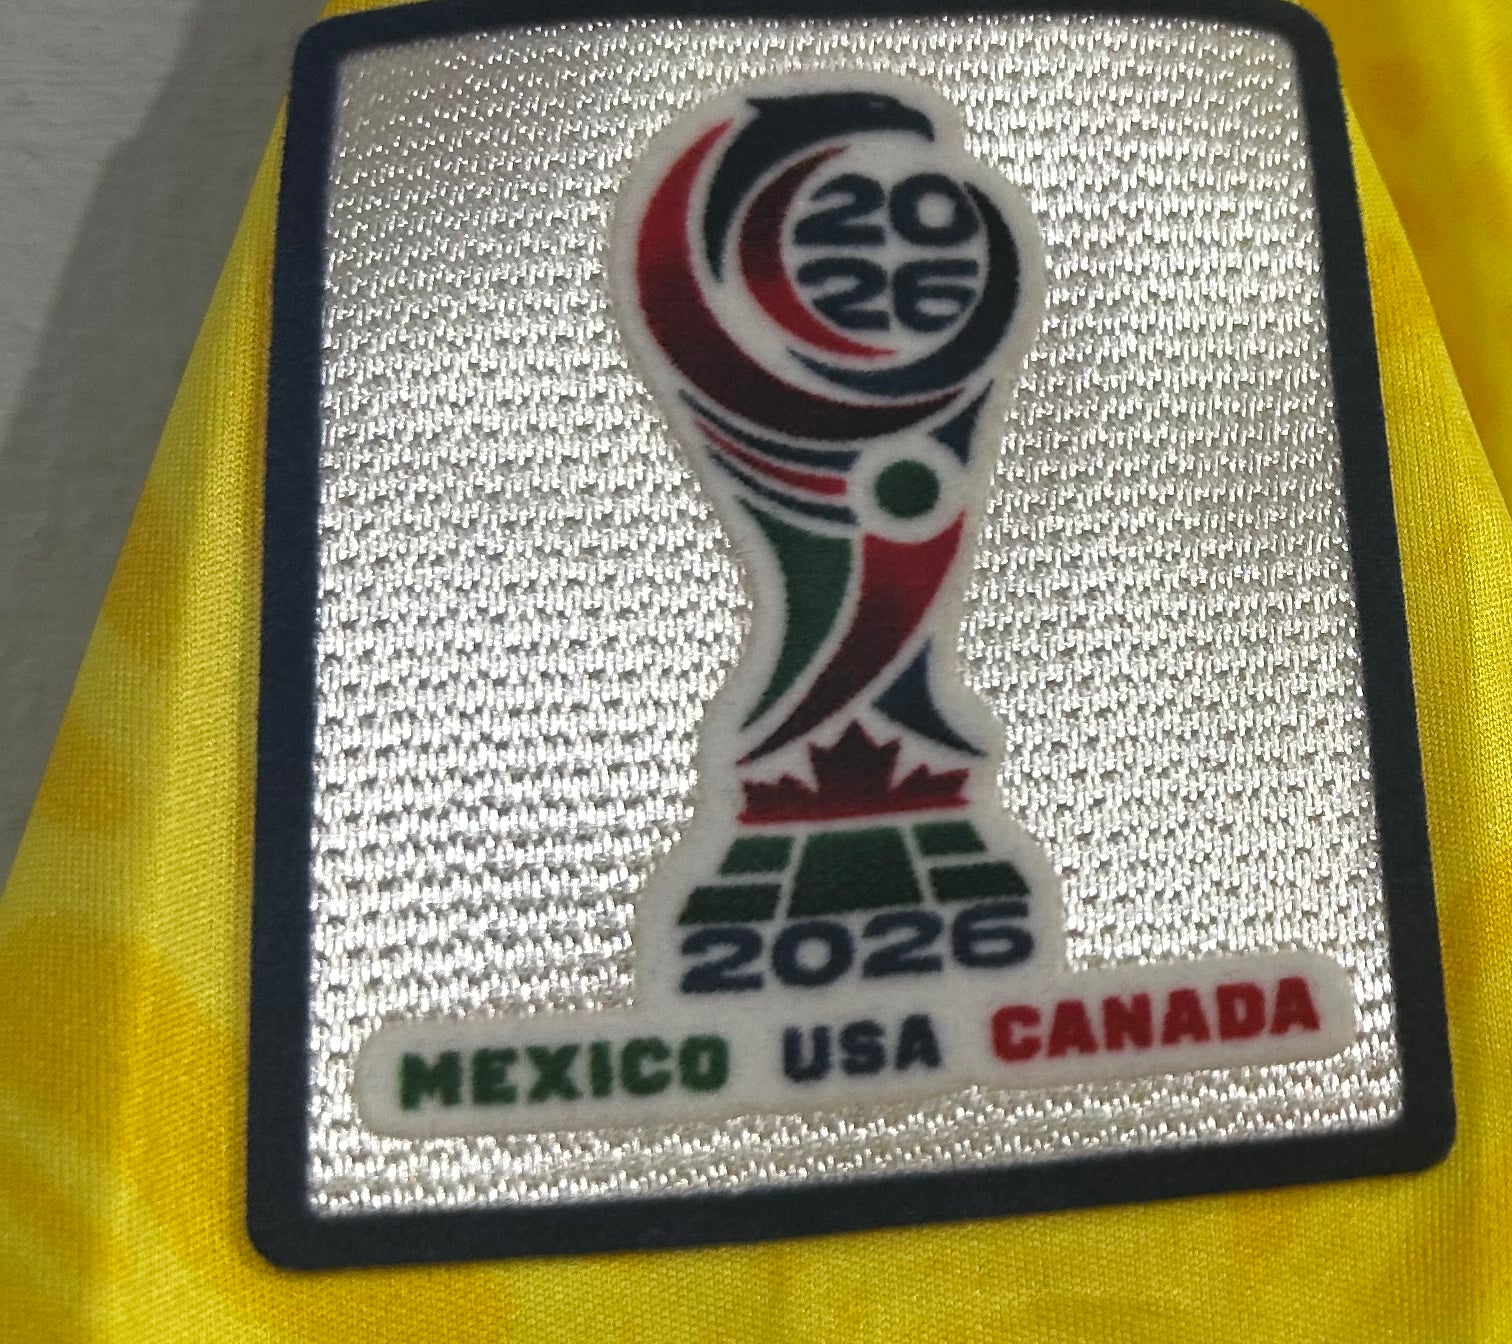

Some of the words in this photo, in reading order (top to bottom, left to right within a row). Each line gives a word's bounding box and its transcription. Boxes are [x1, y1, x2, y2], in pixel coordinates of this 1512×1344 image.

[794, 173, 979, 246] 20
[796, 257, 978, 333] 26
[678, 909, 1036, 993] 2026
[399, 1034, 731, 1110] MEXICO
[780, 1014, 942, 1084] USA
[990, 976, 1322, 1062] CANADA
